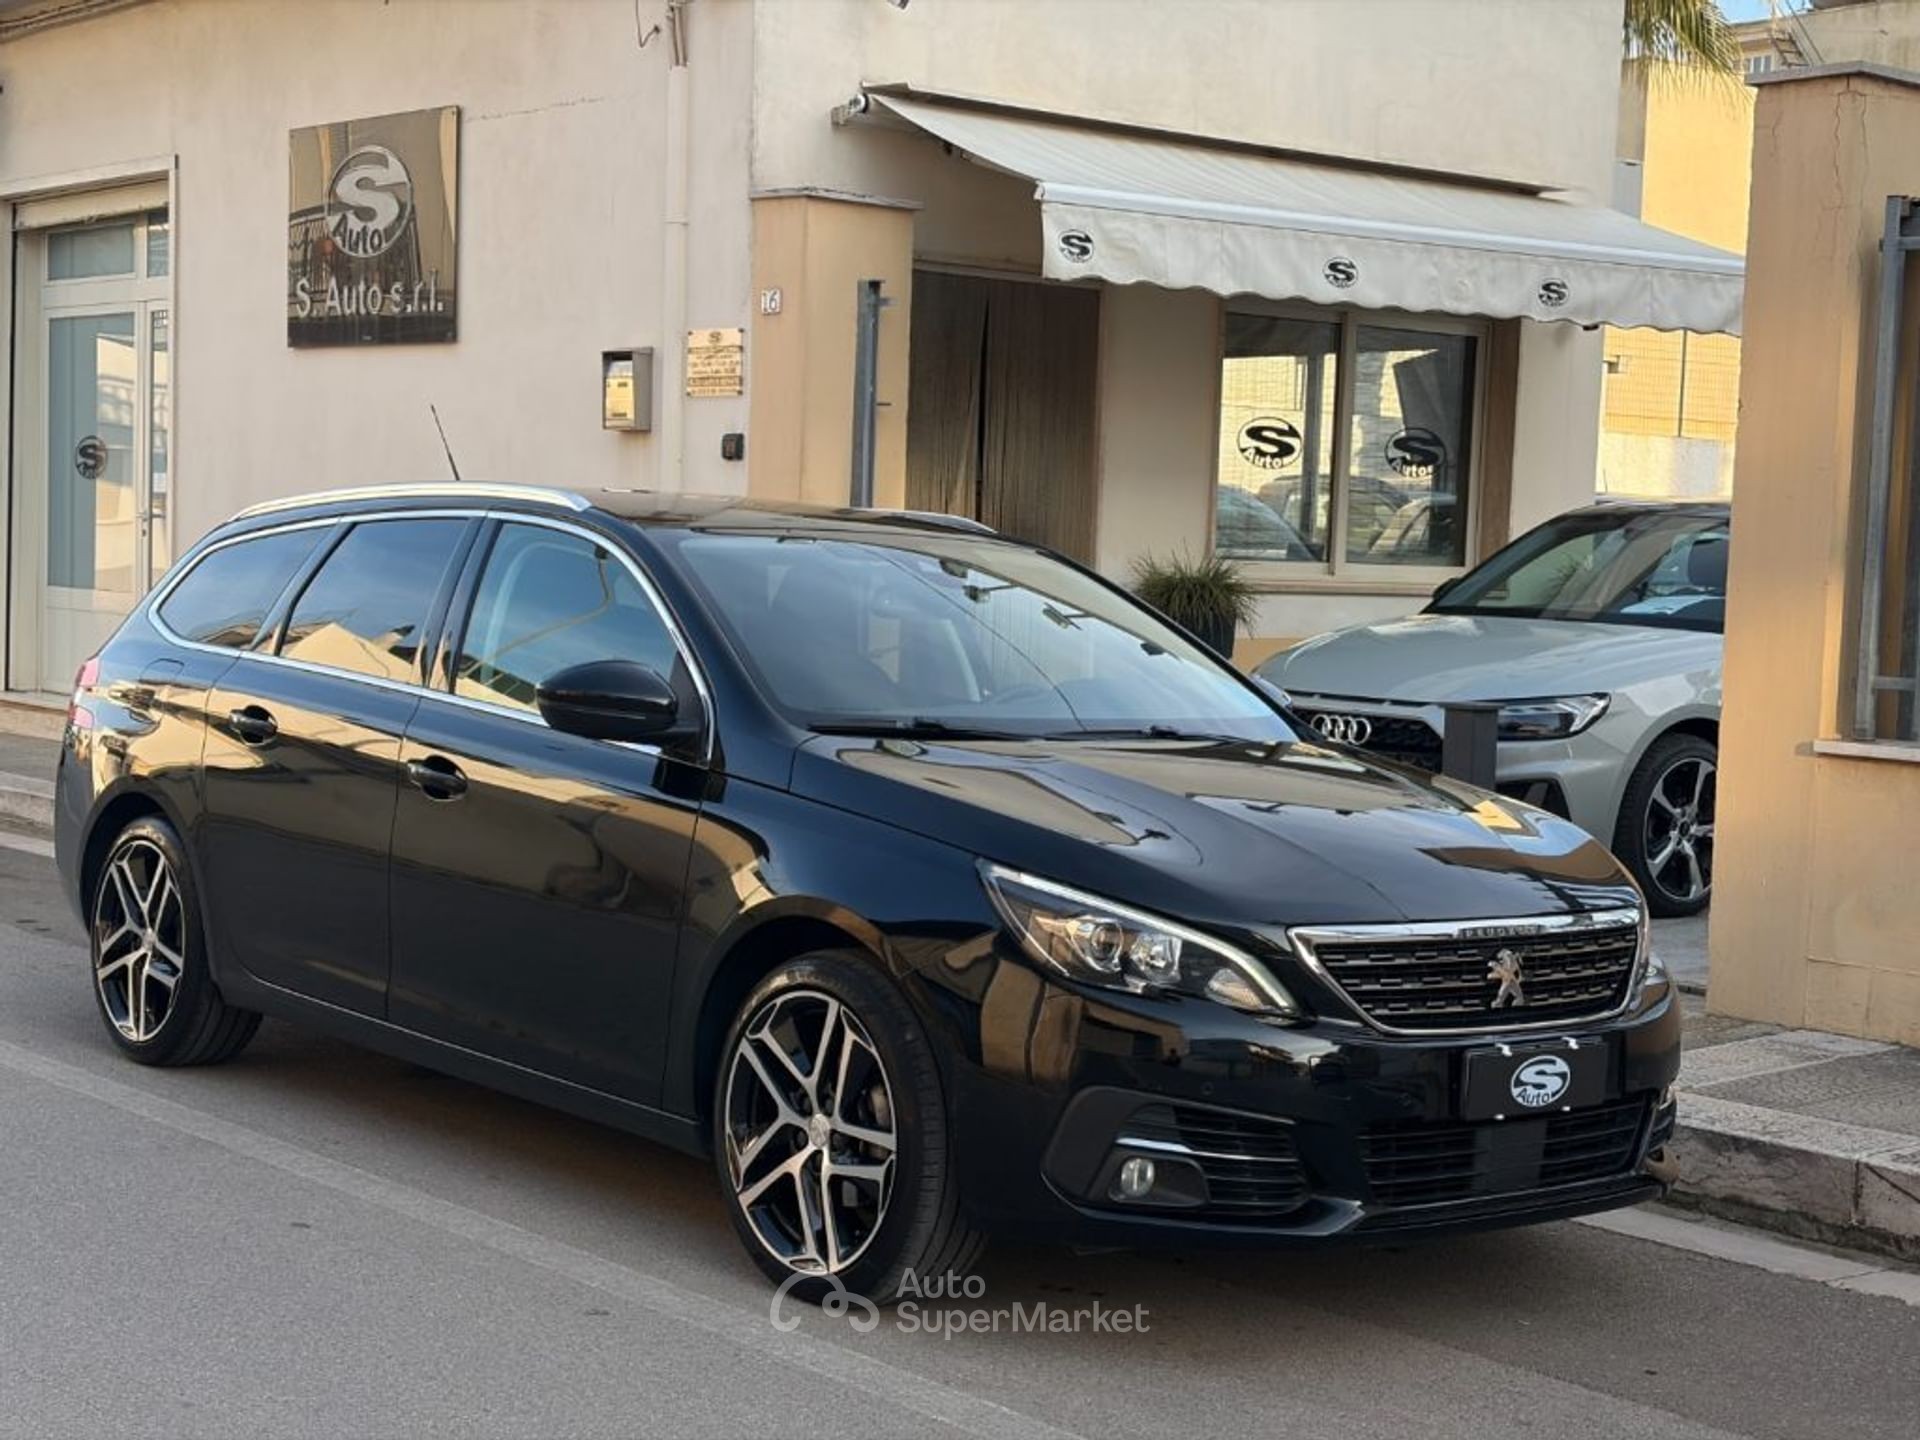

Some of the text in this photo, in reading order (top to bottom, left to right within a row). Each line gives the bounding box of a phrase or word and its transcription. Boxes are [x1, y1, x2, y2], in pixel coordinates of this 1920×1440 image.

[332, 214, 384, 255] Auto
[1061, 233, 1092, 256] S
[1328, 260, 1356, 282] S
[325, 274, 383, 315] Auto
[1542, 281, 1568, 301] S
[1246, 424, 1300, 458] S
[1245, 449, 1283, 470] Auto
[1515, 1087, 1551, 1105] Auto
